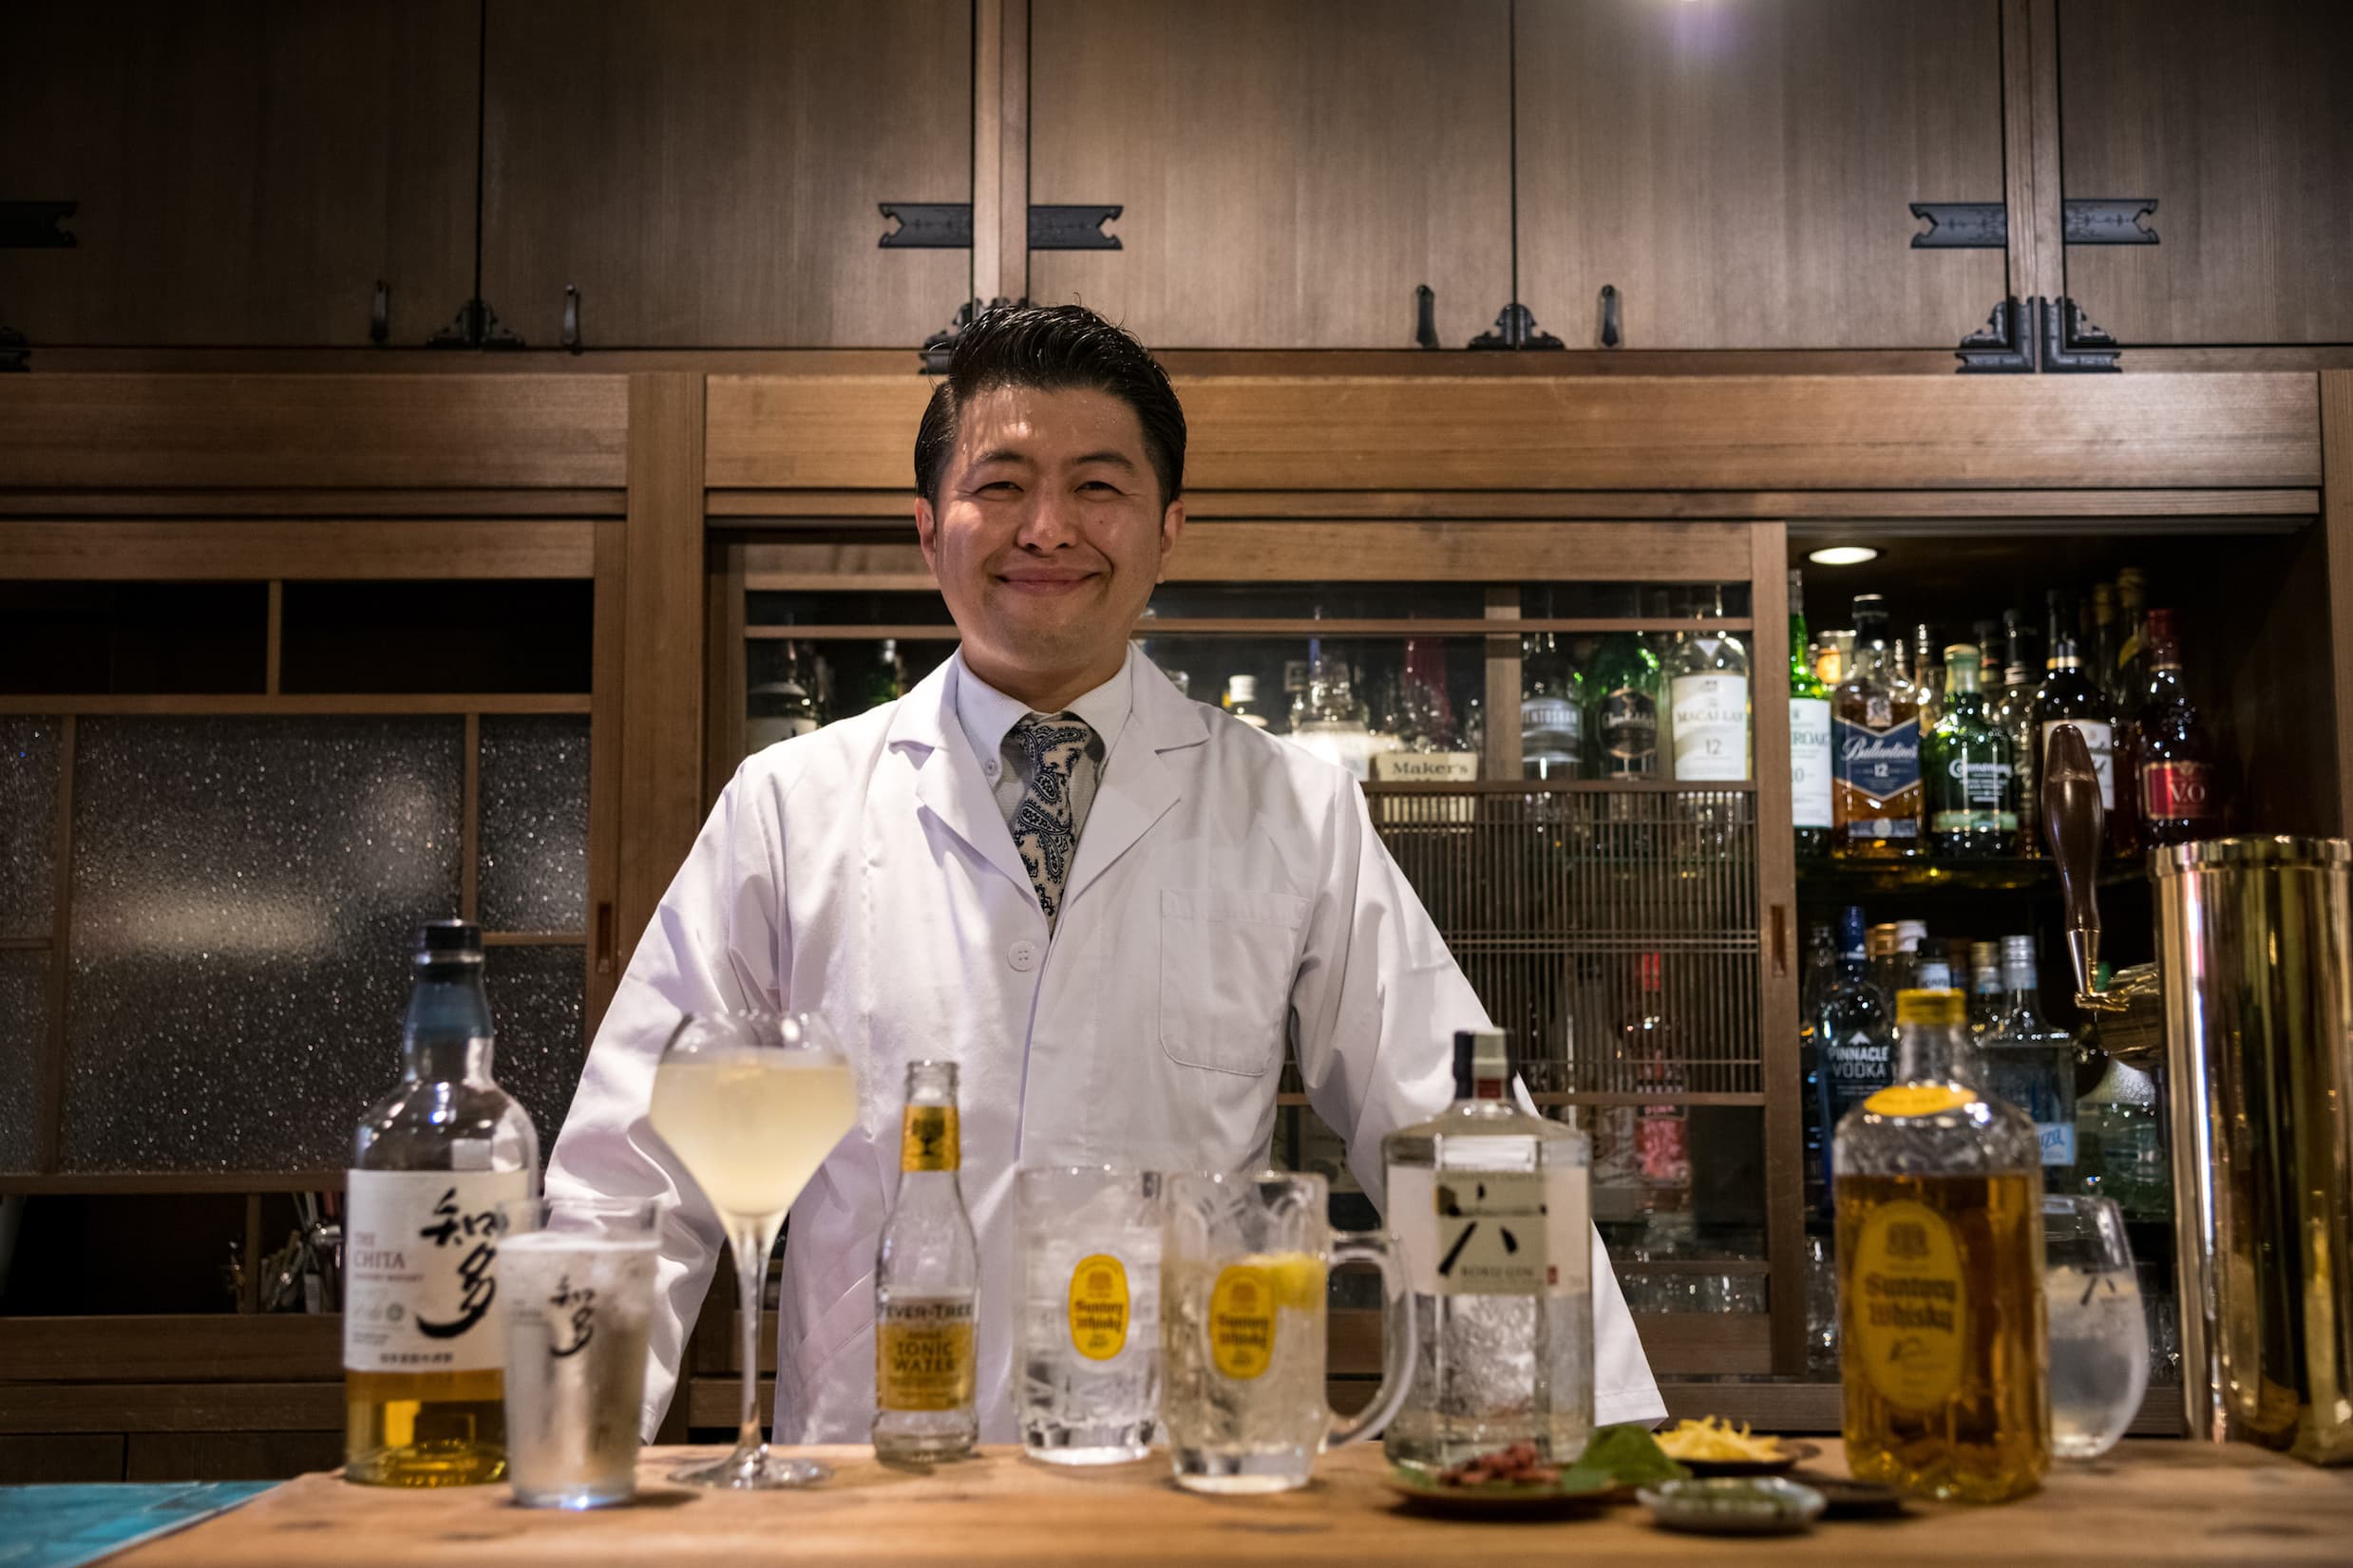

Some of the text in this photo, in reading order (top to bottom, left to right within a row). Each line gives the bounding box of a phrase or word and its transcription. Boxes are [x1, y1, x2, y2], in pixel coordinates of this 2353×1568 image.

[1705, 739, 1722, 755] 12
[1392, 762, 1469, 775] Maker's
[1873, 763, 1889, 777] 12
[1827, 1046, 1889, 1062] PINNACLE
[1832, 1063, 1887, 1079] VODKA
[354, 1251, 406, 1270] CHITA
[1866, 1273, 1957, 1305] Suntory
[1075, 1299, 1125, 1318] Suntory
[1076, 1316, 1122, 1334] Whisky
[1218, 1313, 1269, 1332] Suntory
[896, 1341, 954, 1356] TONIC
[1219, 1332, 1268, 1351] Whisky
[895, 1358, 956, 1373] WATER
